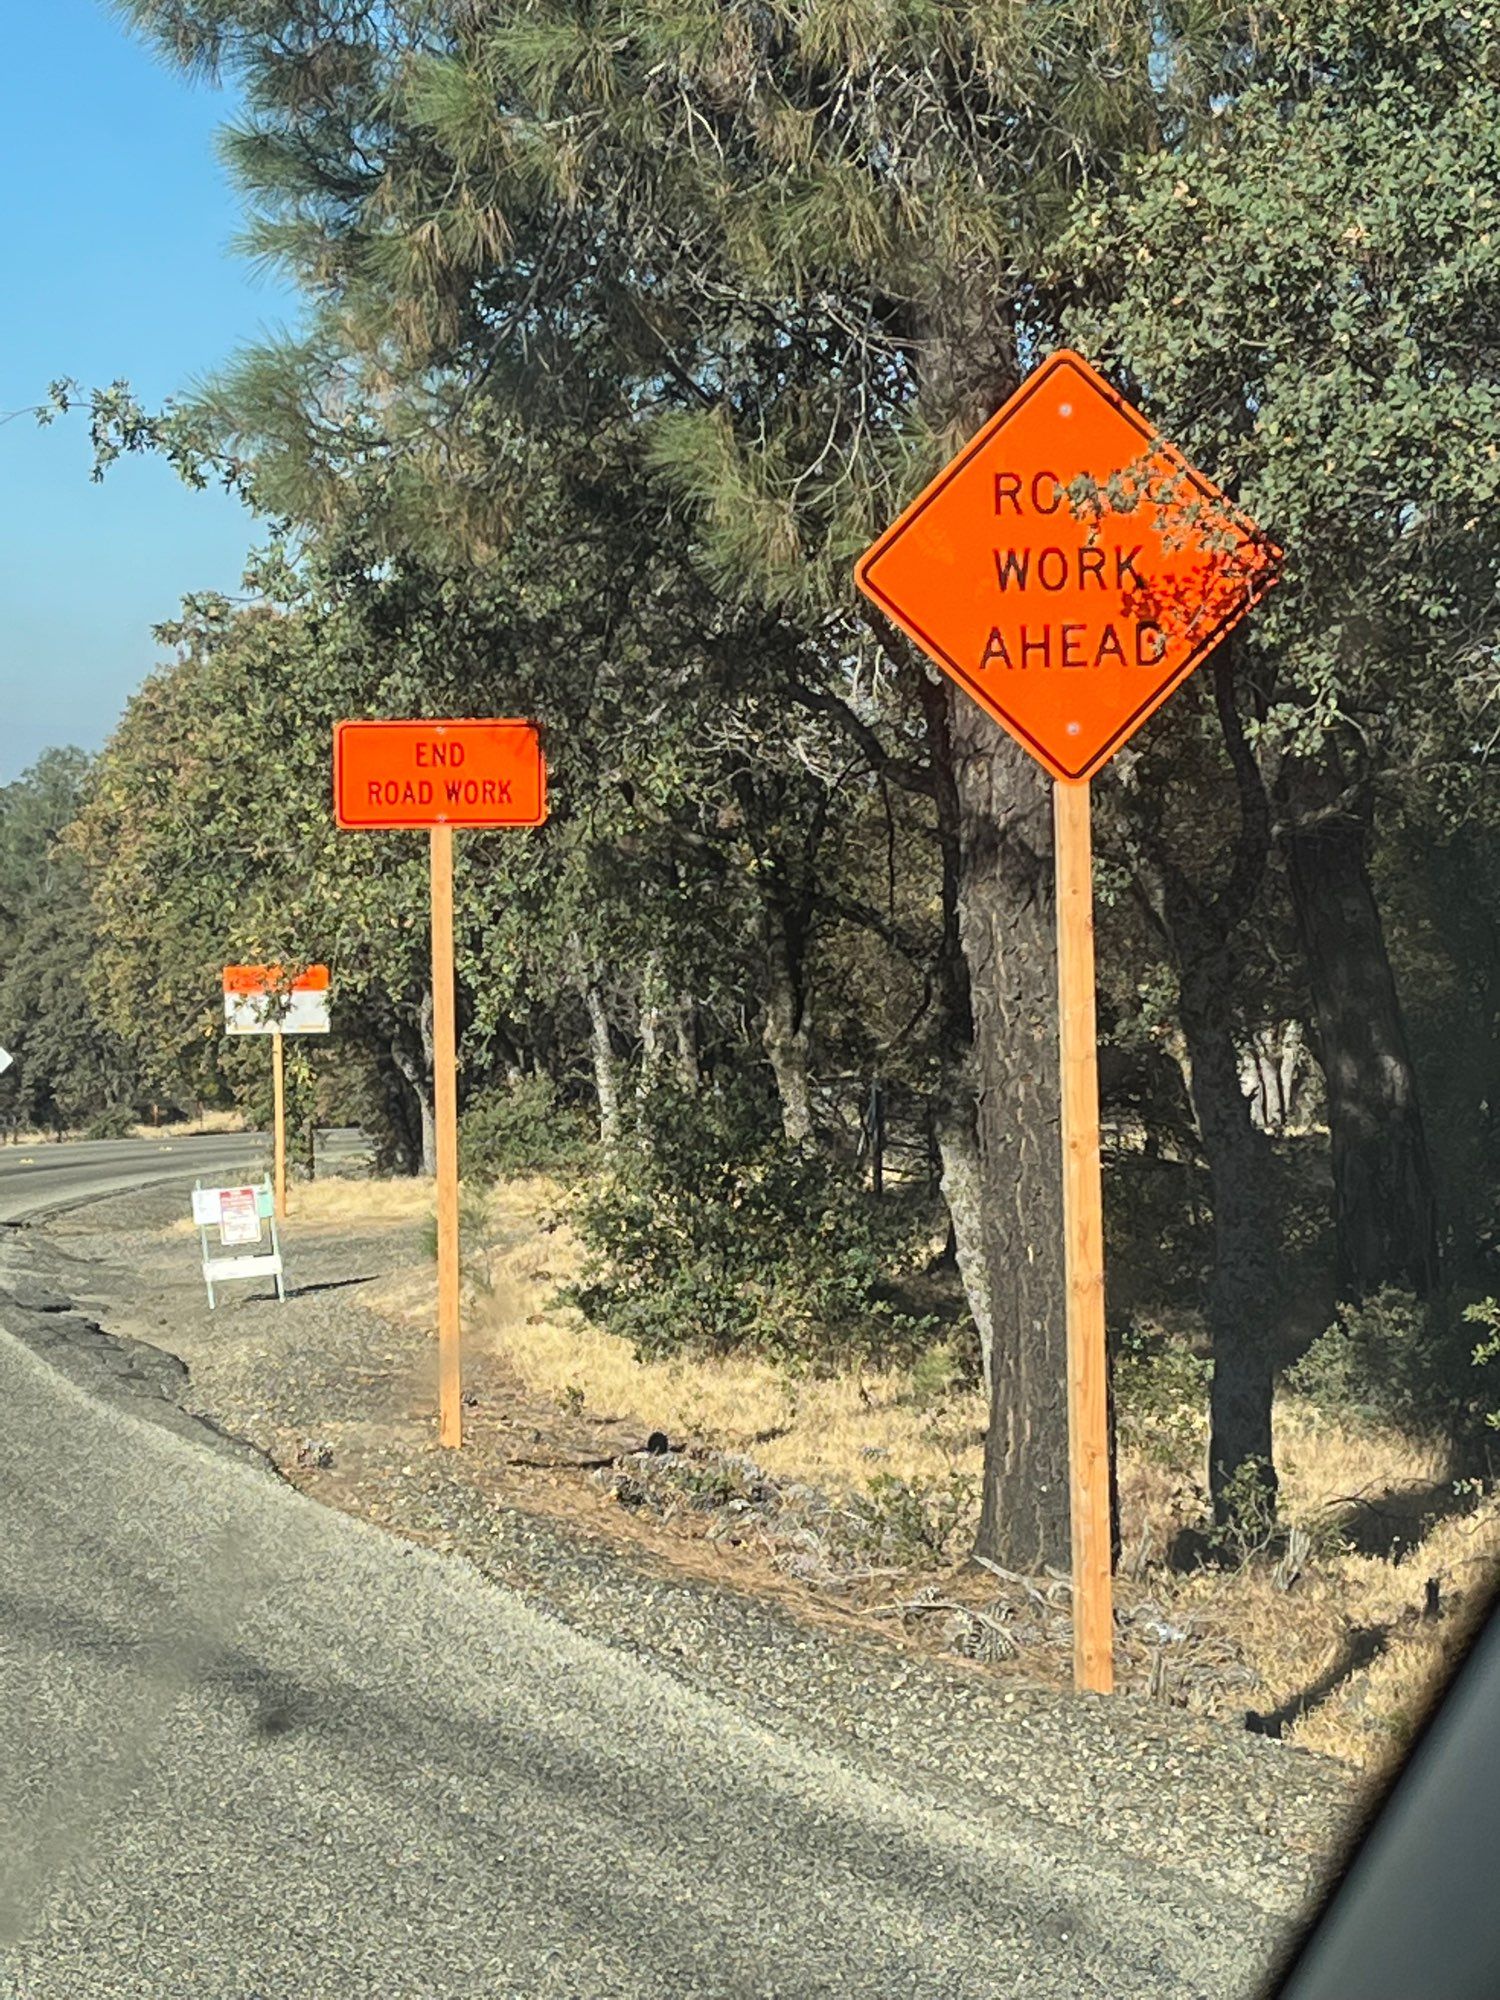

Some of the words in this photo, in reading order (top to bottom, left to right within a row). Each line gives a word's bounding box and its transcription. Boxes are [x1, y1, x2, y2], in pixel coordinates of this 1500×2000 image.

[994, 471, 1137, 515] RO
[992, 545, 1145, 591] WORK
[979, 620, 1166, 669] AHEAD
[415, 742, 465, 767] END
[368, 780, 433, 805] ROAD
[444, 779, 512, 804] WORK
